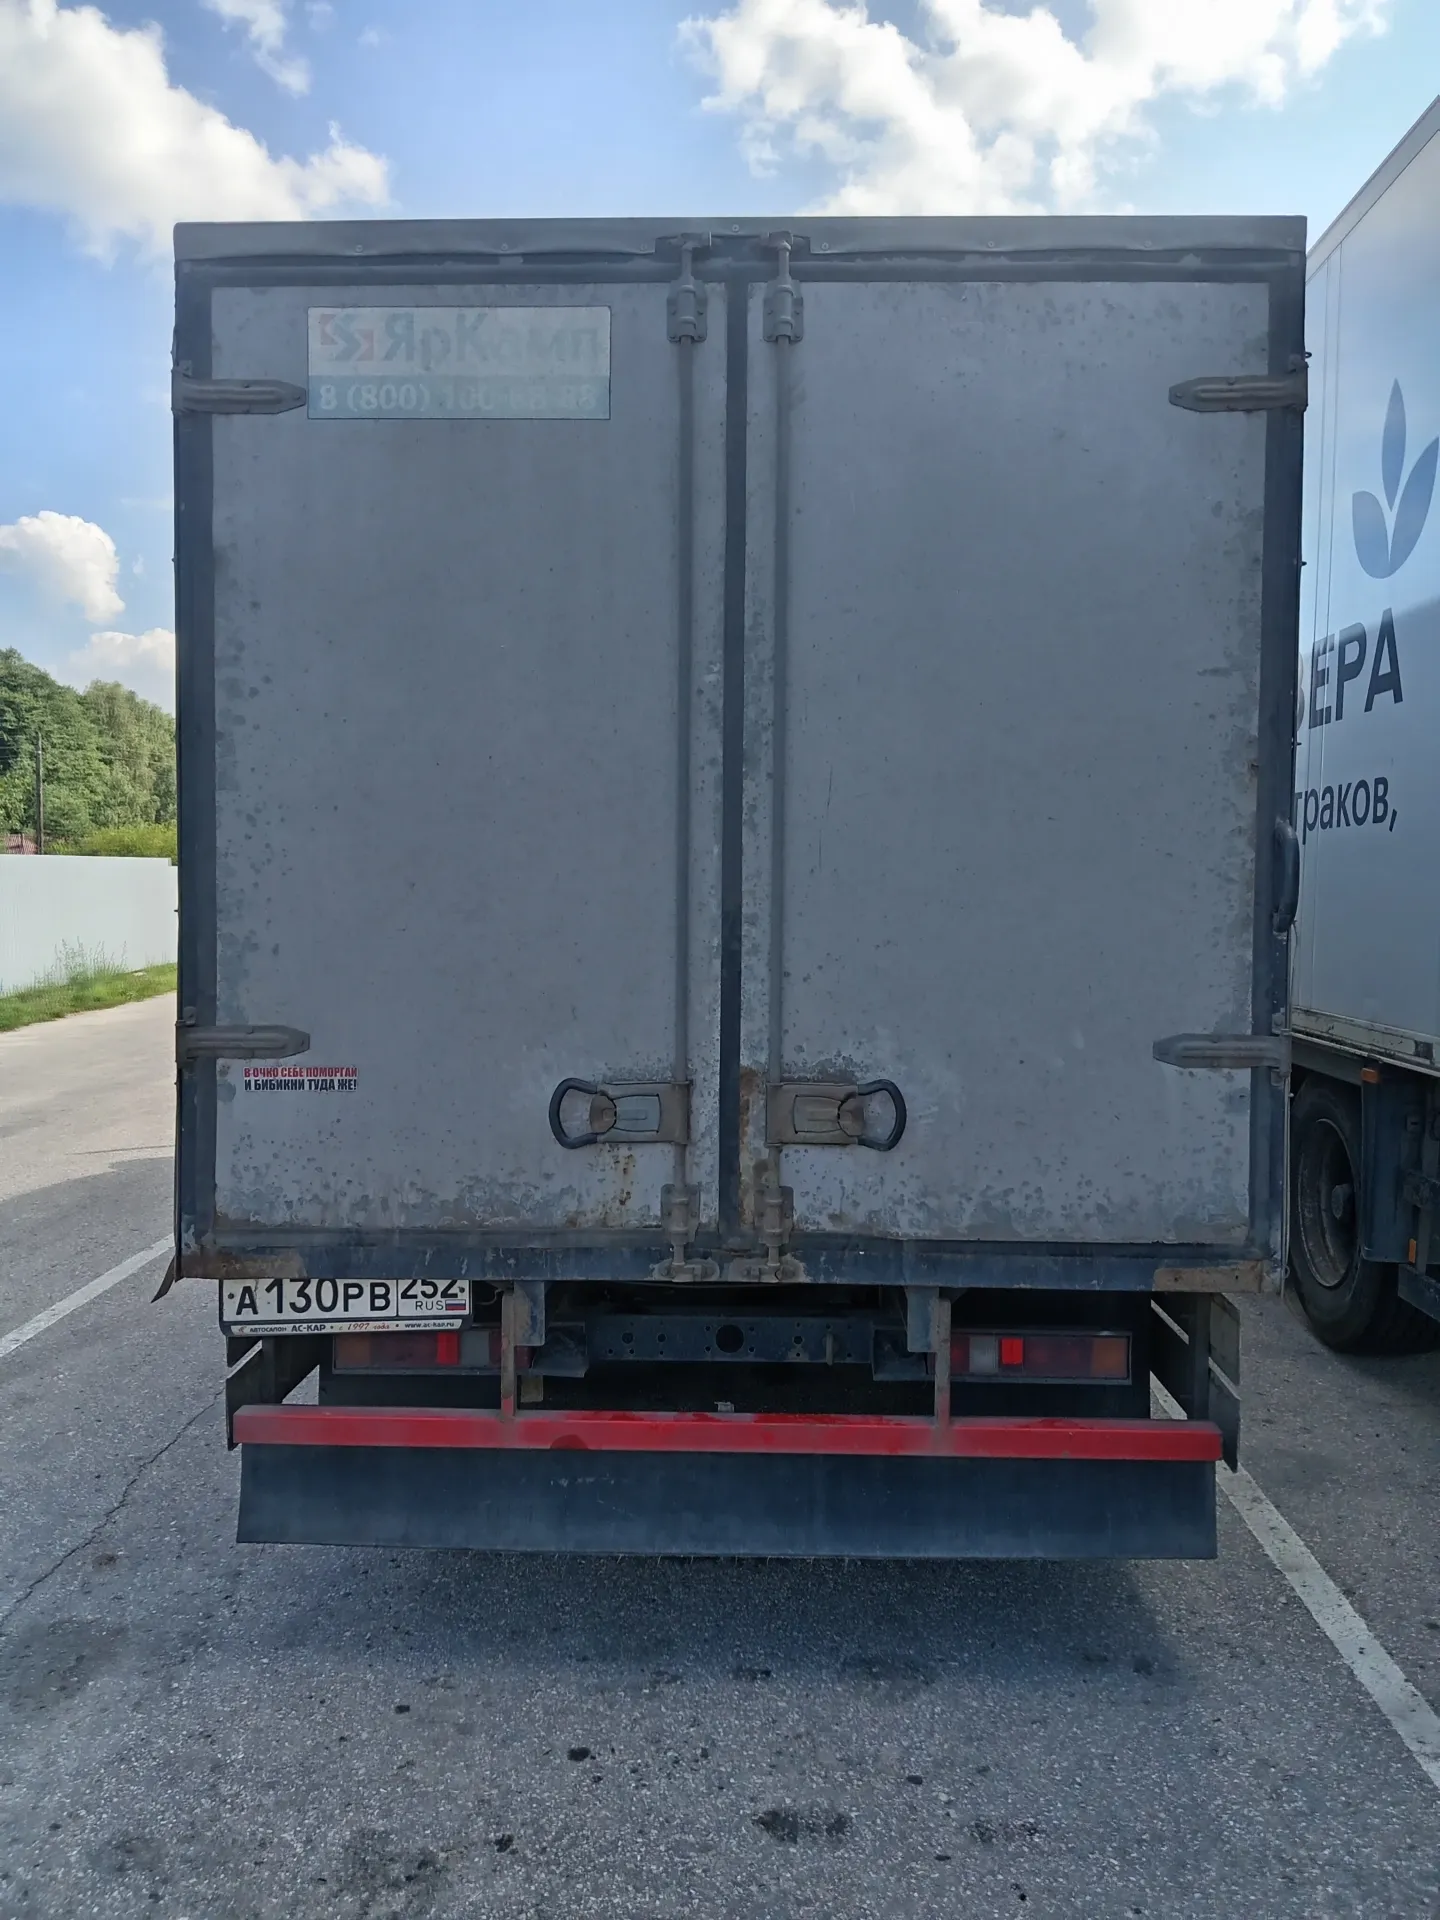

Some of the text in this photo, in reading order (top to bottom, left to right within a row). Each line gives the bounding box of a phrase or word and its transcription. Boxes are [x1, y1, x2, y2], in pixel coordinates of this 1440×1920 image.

[319, 384, 337, 410] 8
[346, 383, 430, 412] (800)
[244, 1067, 251, 1077] В
[253, 1067, 279, 1078] ОЧКО
[281, 1067, 304, 1078] СЕБЕ
[244, 1079, 357, 1092] И БИБИКНИ ТУДА ЖЕ!
[400, 1279, 458, 1299] 252
[415, 1300, 444, 1311] RUS
[348, 1323, 370, 1331] 1997
